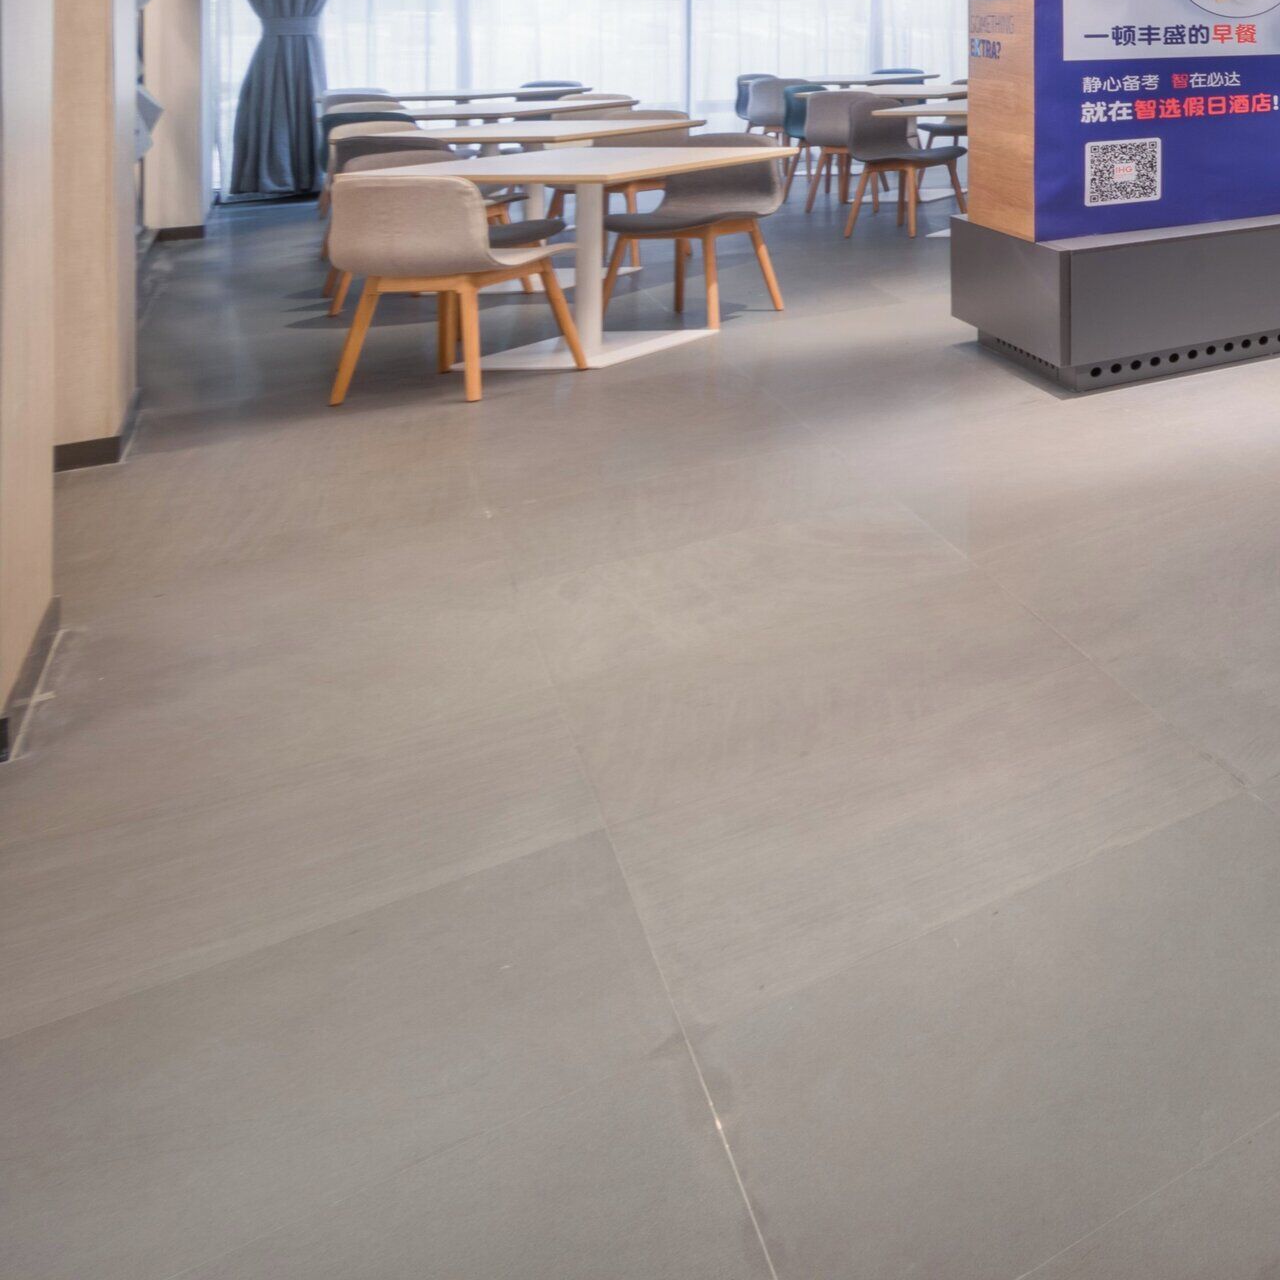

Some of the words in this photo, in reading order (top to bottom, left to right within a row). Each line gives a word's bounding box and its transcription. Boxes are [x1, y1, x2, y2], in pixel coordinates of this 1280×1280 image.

[970, 15, 1014, 34] SOMETHING
[1084, 24, 1257, 46] 一顿丰盛的早餐
[970, 38, 1001, 59] EXTRA?
[1082, 74, 1159, 93] 静心备考
[1171, 71, 1241, 89] 智在必达
[1081, 93, 1279, 123] 就在智选假日酒店!
